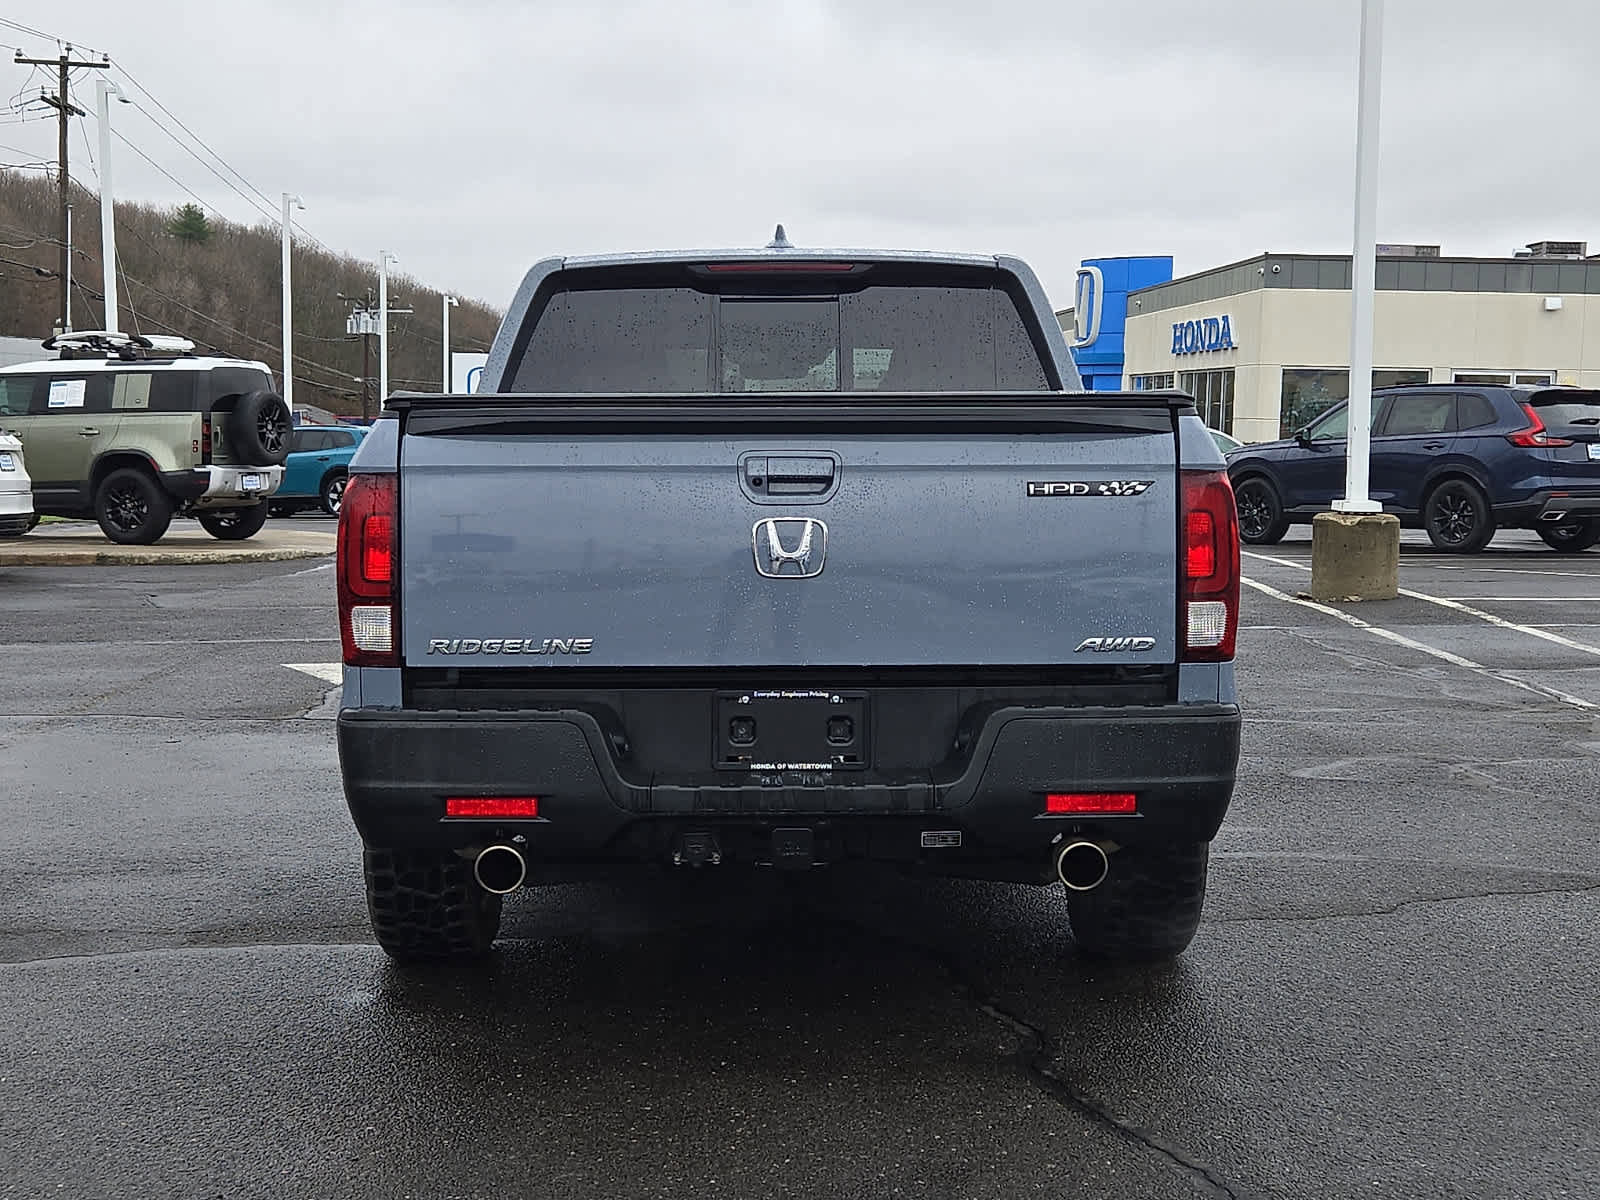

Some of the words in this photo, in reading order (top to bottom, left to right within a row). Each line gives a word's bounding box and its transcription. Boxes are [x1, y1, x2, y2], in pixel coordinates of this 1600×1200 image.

[1171, 314, 1235, 354] HONDA
[1028, 482, 1090, 495] HPD
[427, 638, 594, 655] RIDGELINE
[1073, 636, 1156, 653] AWD
